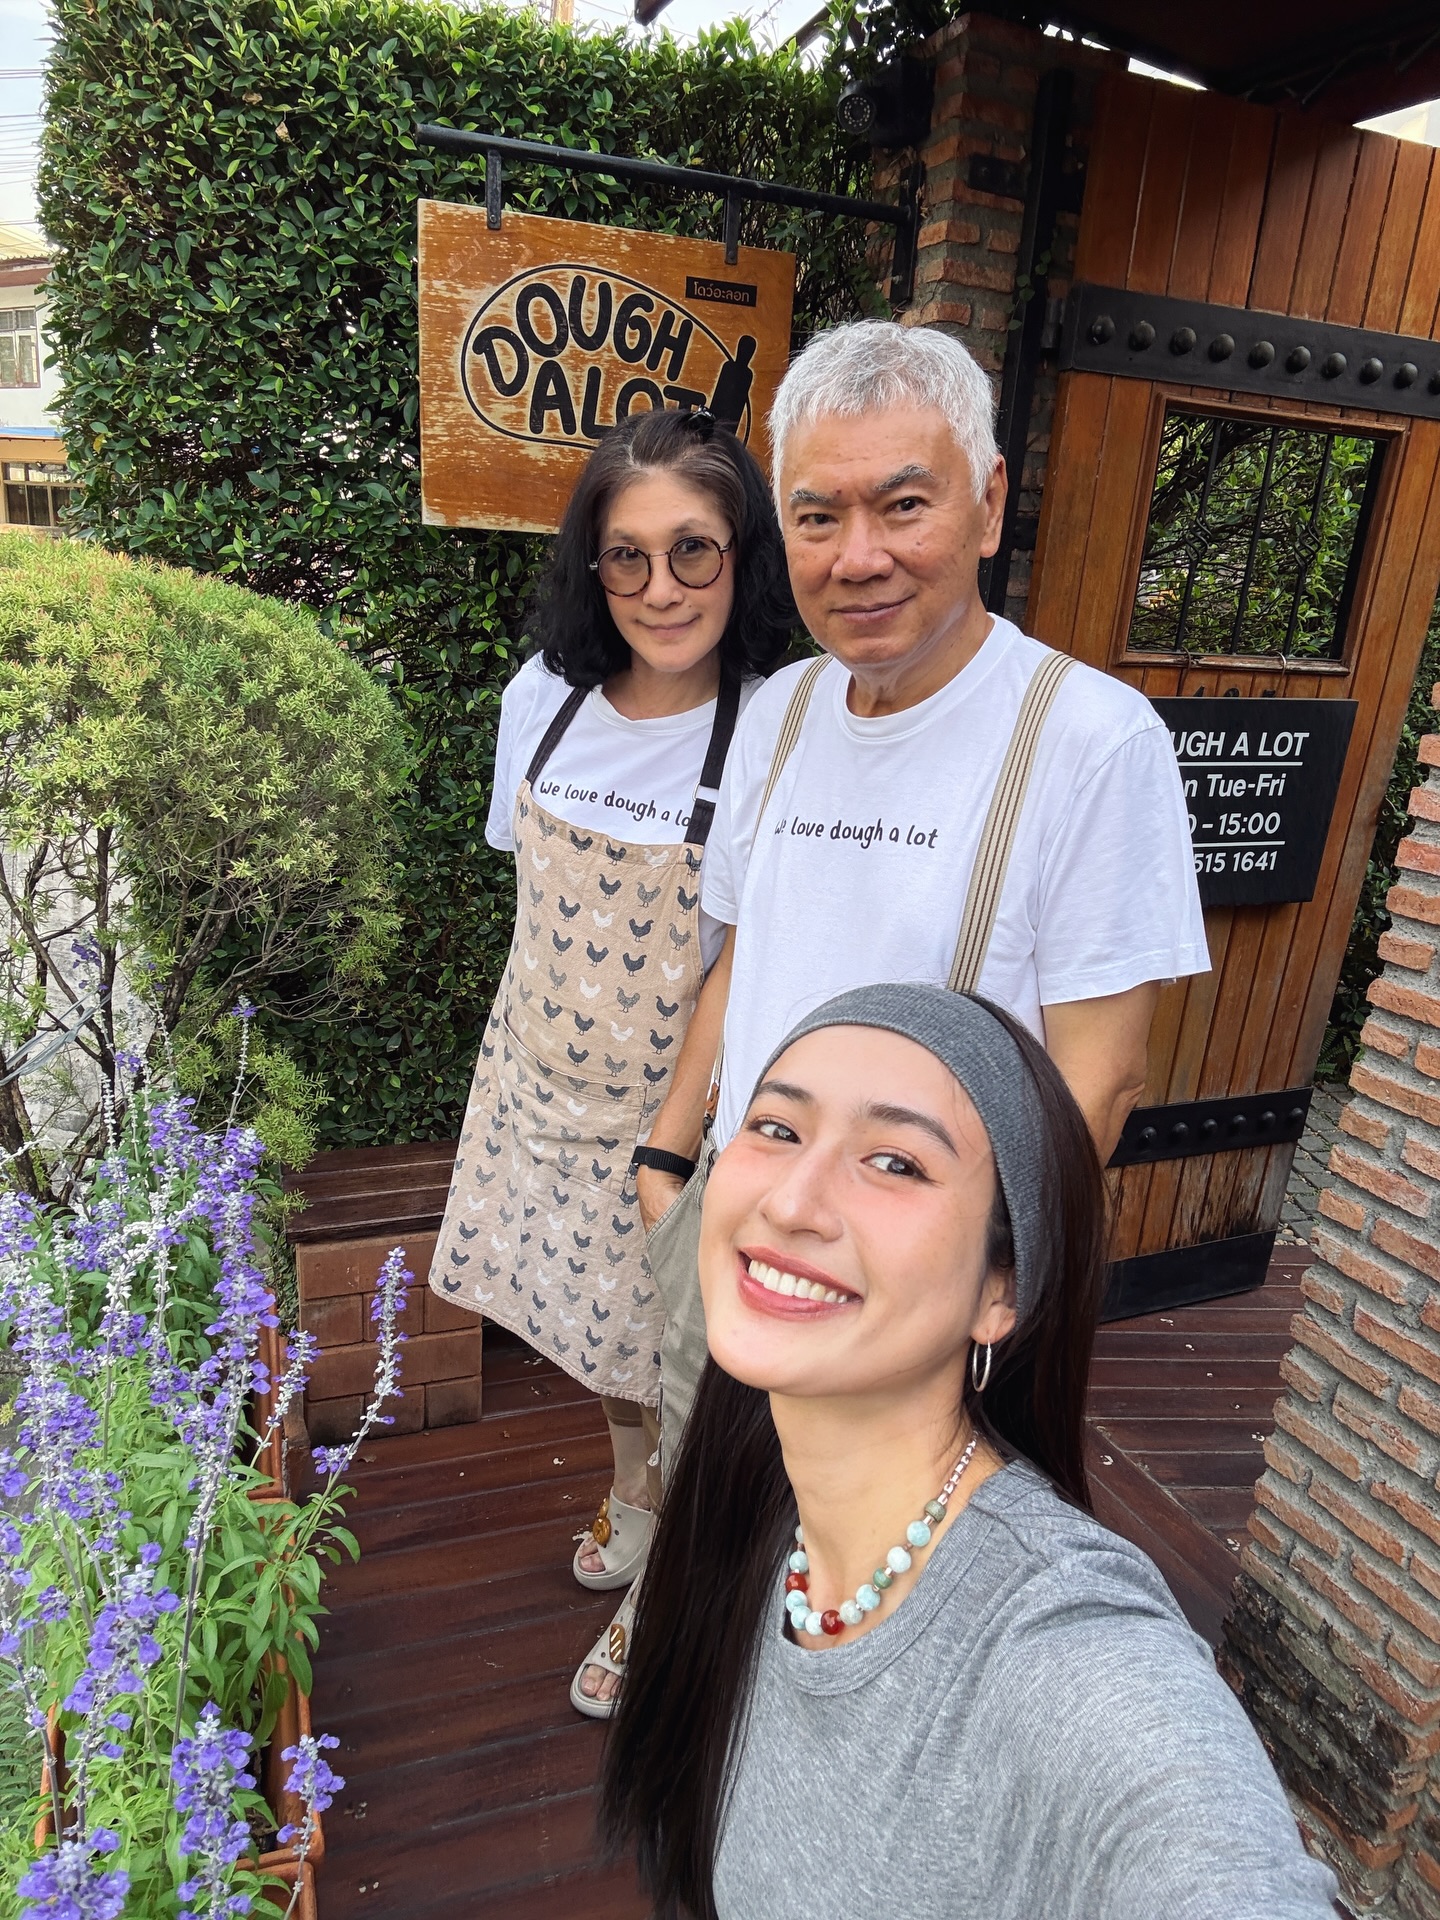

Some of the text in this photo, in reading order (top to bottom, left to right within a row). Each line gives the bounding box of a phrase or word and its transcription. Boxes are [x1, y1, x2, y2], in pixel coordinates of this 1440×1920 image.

[472, 275, 693, 396] DOUGH
[1170, 731, 1310, 756] UGH A LOT
[1206, 773, 1287, 797] Tue-Fri
[564, 784, 598, 803] love
[604, 790, 657, 822] dough
[661, 810, 671, 822] a
[675, 809, 691, 827] lo
[791, 816, 824, 837] love
[830, 818, 883, 850] dough
[889, 827, 900, 843] a
[906, 825, 938, 849] lot
[1219, 812, 1281, 835] 15:00
[1233, 851, 1278, 872] 1641
